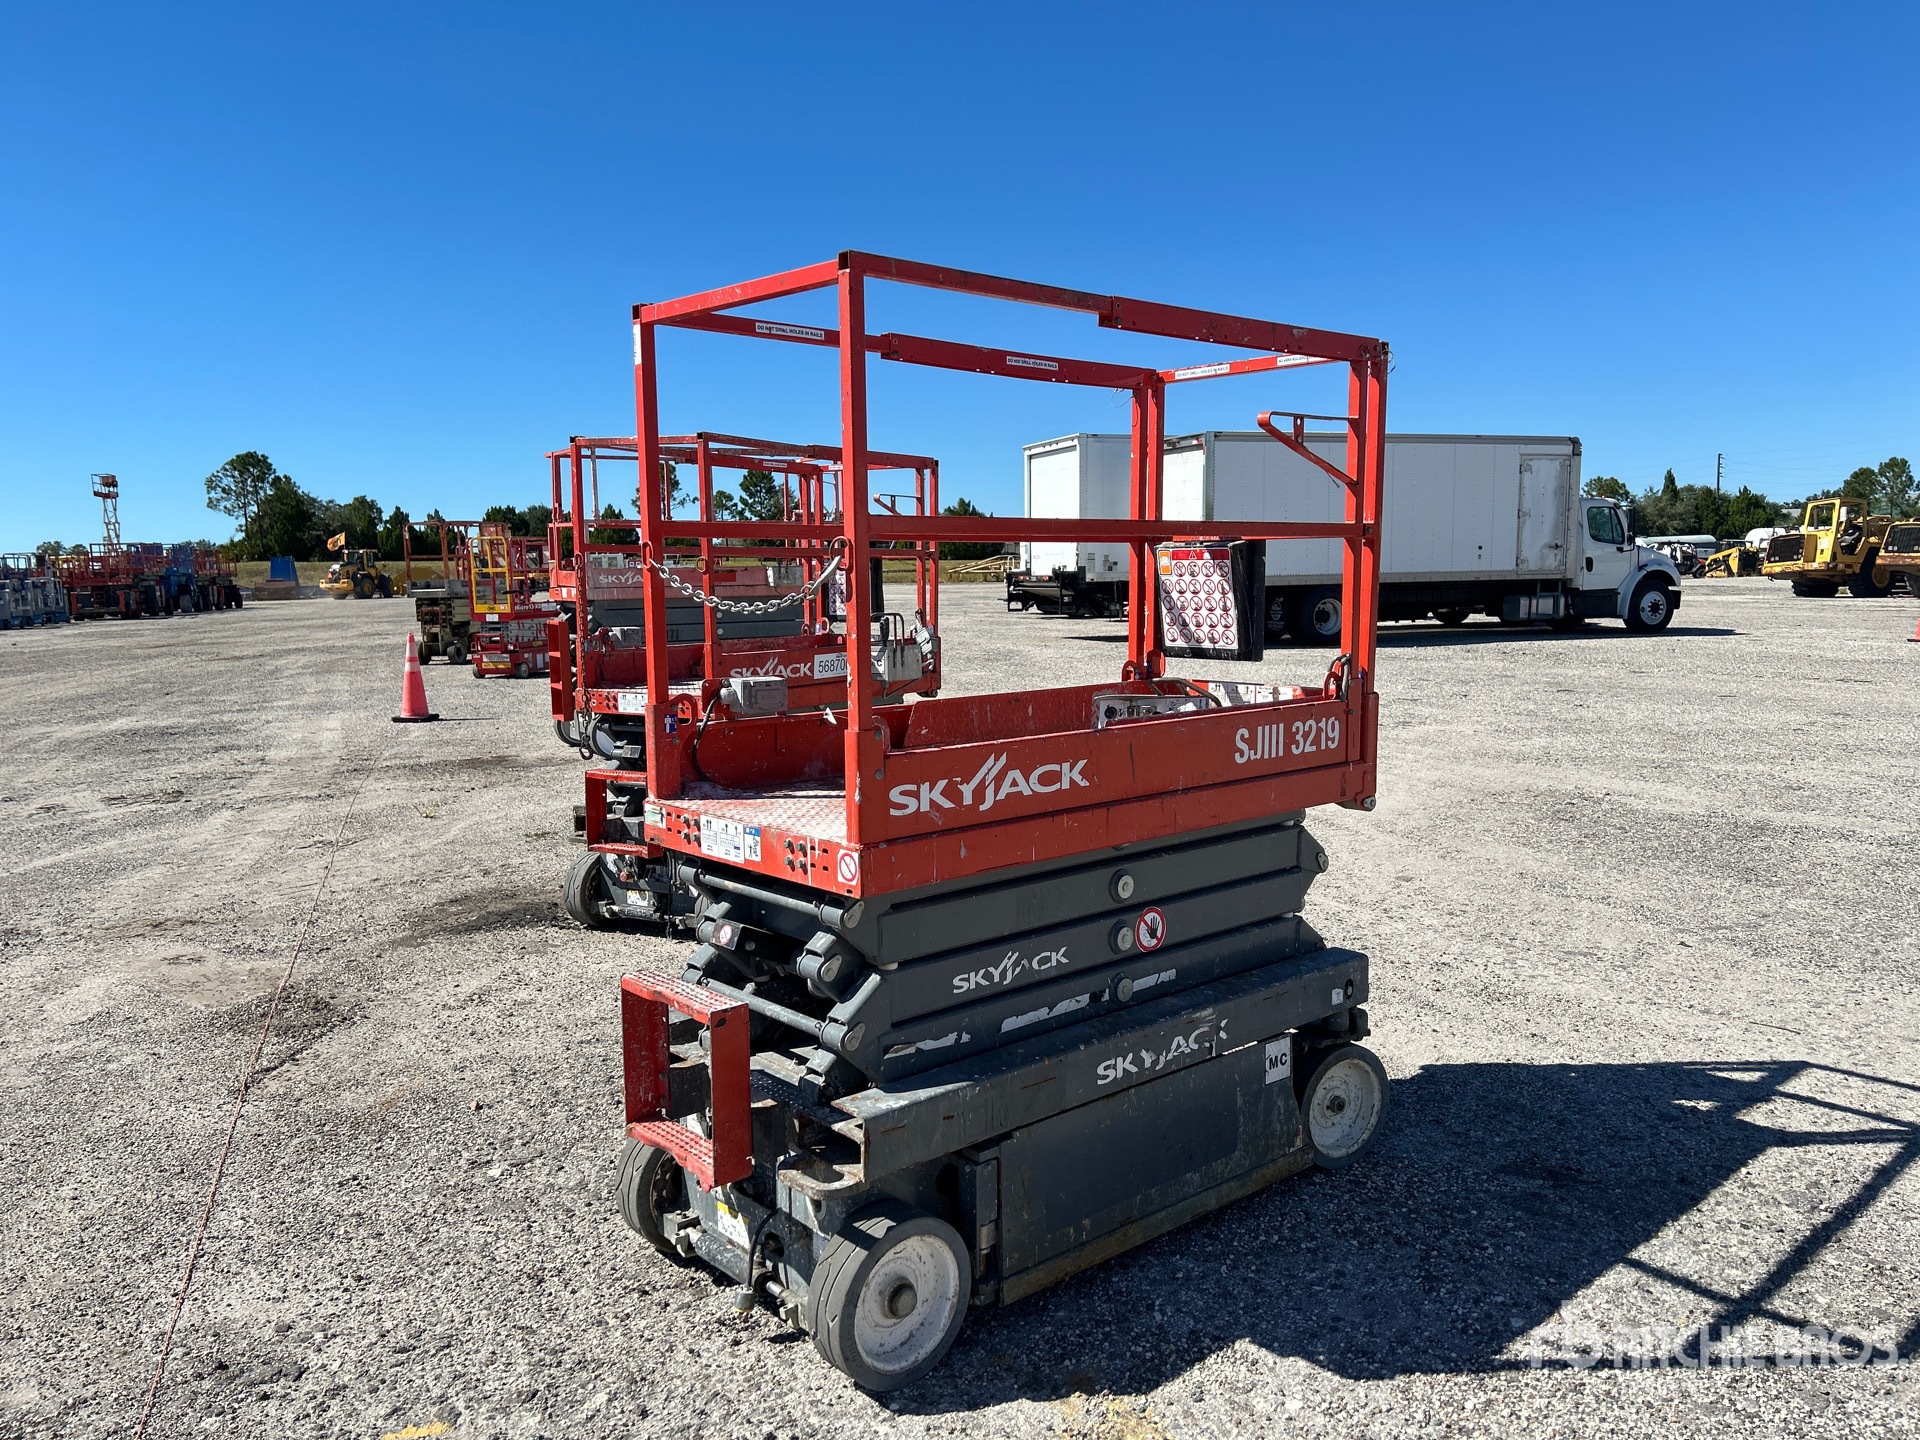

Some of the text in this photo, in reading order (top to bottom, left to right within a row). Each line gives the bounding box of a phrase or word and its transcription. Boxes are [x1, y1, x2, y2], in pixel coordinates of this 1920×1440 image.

[599, 571, 643, 585] SKYJA
[818, 658, 848, 674] 56870
[1291, 716, 1340, 755] 3219
[888, 751, 1090, 816] SKYJACK
[952, 946, 1069, 993] SKYJACK
[1269, 1052, 1288, 1071] MC
